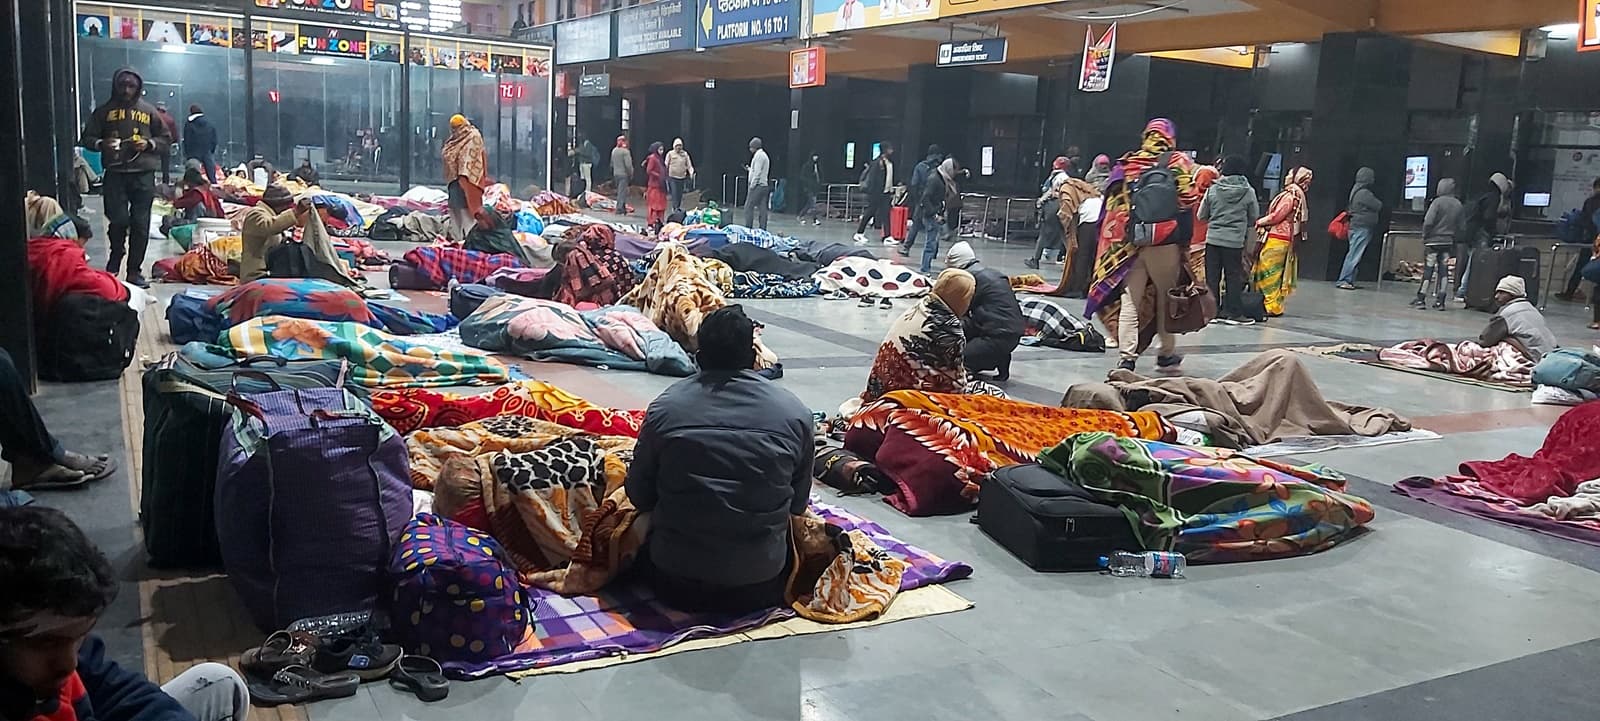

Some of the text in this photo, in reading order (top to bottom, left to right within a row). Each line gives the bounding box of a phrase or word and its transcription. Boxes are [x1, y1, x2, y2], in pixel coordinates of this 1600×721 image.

[717, 15, 789, 40] PLATFORM NO. 16 TO 1
[299, 36, 327, 50] FUN
[329, 38, 367, 54] ZONE
[130, 109, 150, 125] YORK
